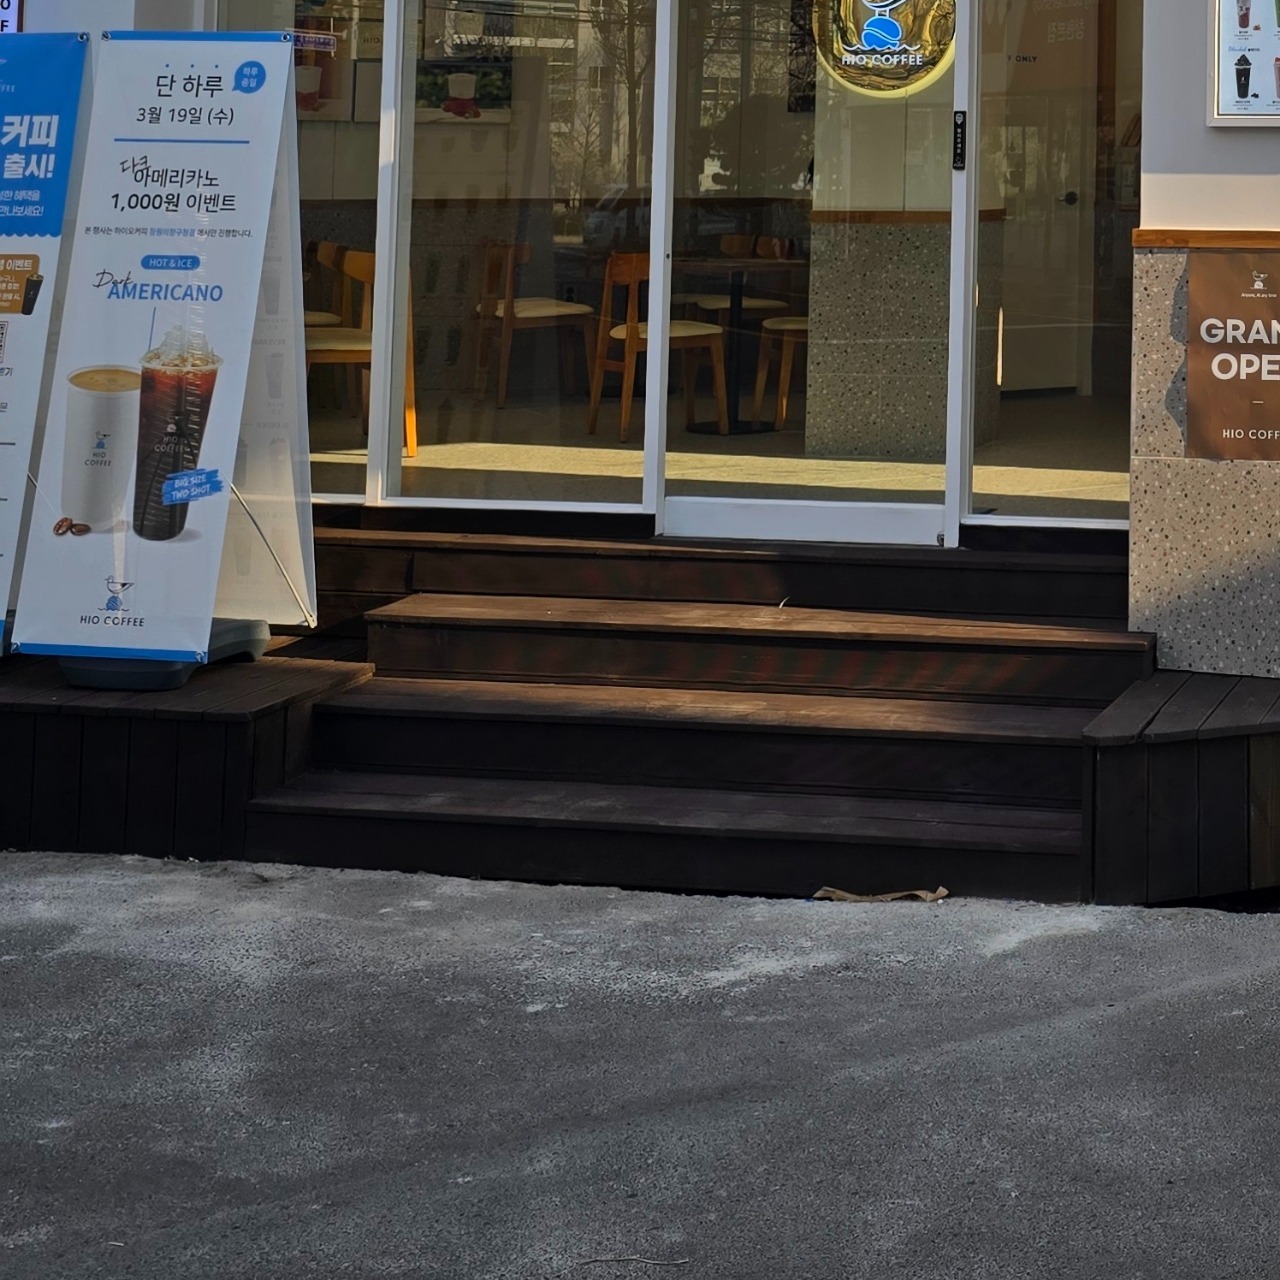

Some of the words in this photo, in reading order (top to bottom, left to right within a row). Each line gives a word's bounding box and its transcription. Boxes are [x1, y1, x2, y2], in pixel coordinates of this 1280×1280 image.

[841, 54, 867, 65] HIO
[872, 54, 923, 66] COFFEE
[1015, 55, 1038, 63] ONLY
[156, 74, 176, 97] 단
[183, 74, 224, 98] 하루
[136, 106, 162, 124] 3월
[169, 107, 202, 125] 19일
[207, 107, 234, 126] (수)
[0, 115, 60, 148] 커피
[3, 154, 55, 179] 출시!
[134, 168, 220, 189] 아메리카노
[111, 193, 180, 213] 1,000원
[186, 193, 236, 213] 이벤트
[114, 227, 149, 236] 하이오커피
[150, 258, 168, 267] HOT
[177, 258, 192, 268] ICE
[93, 269, 134, 289] Dark
[107, 283, 223, 302] AMERICANO
[1222, 429, 1245, 440] HIO
[84, 459, 112, 467] COFFEE
[174, 477, 189, 488] BIG
[189, 474, 206, 484] SIZE
[171, 489, 189, 501] TWO
[190, 485, 210, 497] SHOT
[80, 615, 99, 625] HIO
[103, 616, 144, 627] COFFEE
